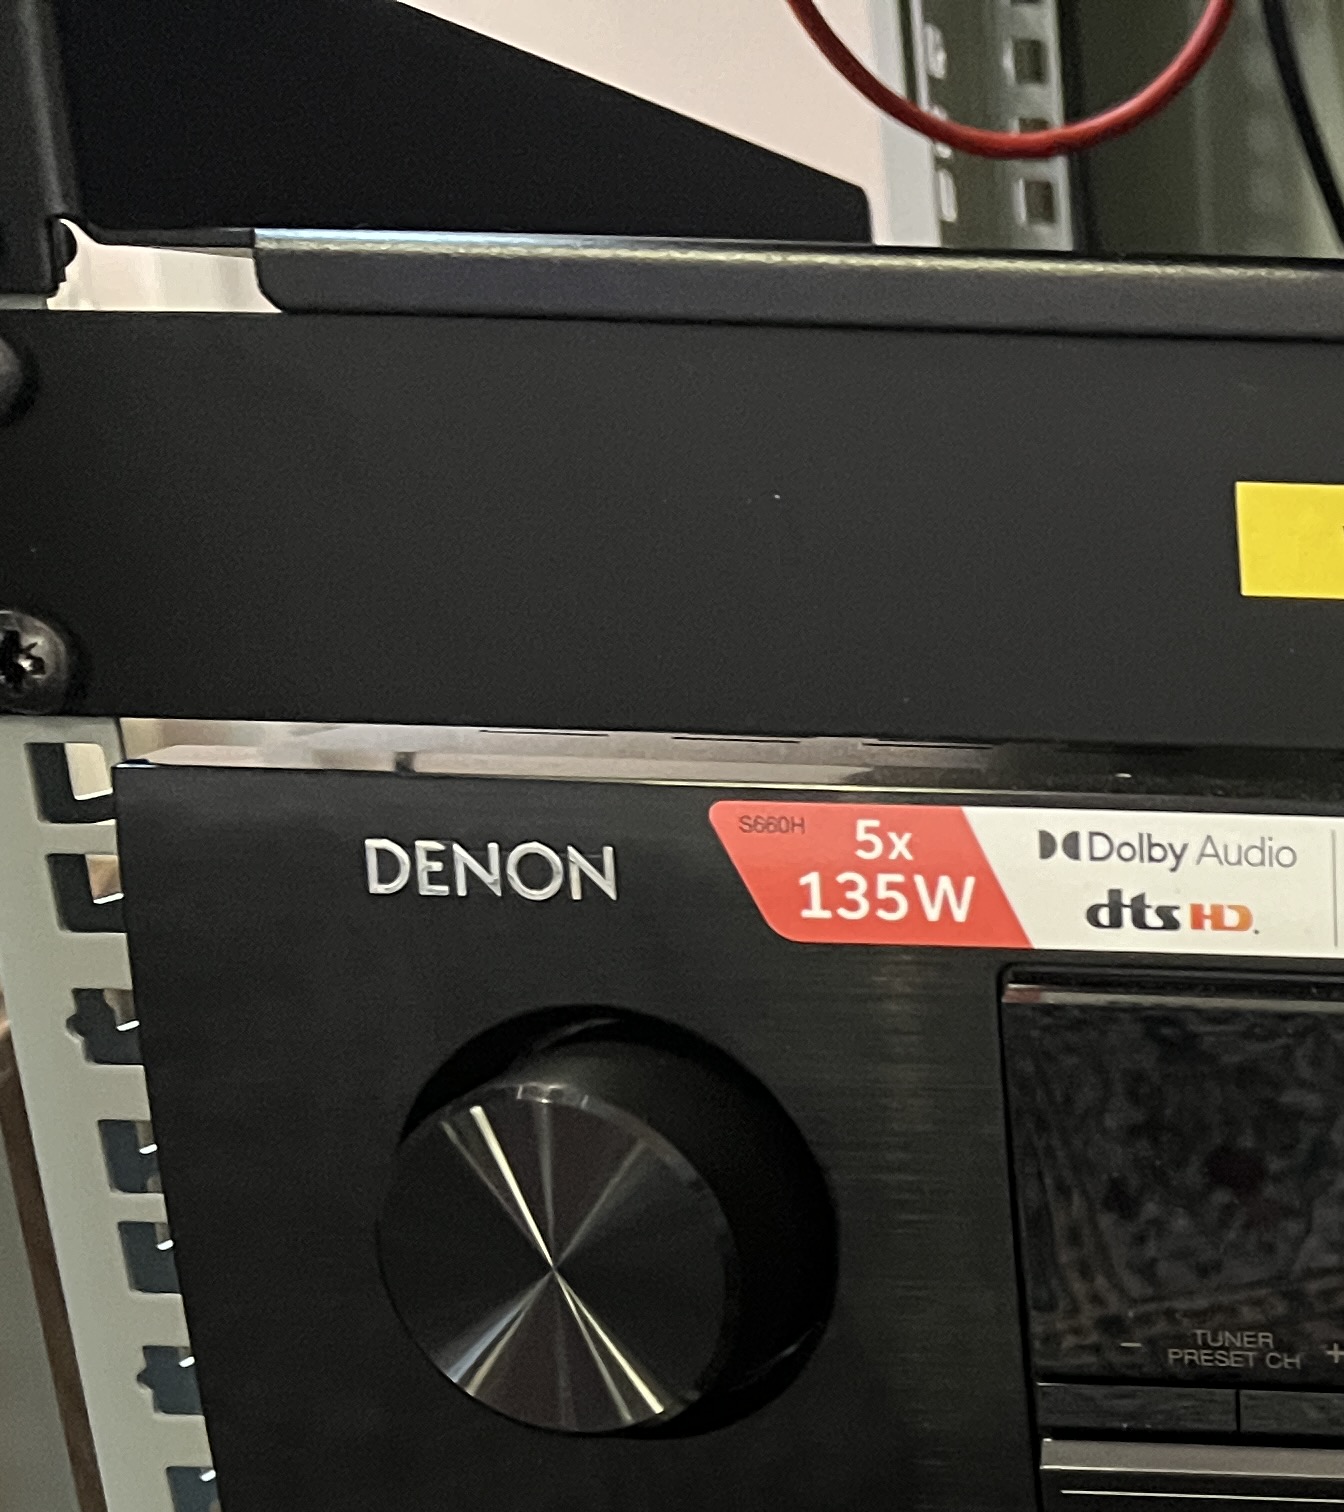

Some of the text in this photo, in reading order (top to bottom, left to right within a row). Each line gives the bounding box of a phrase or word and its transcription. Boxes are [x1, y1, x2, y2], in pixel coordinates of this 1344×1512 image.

[739, 815, 805, 834] S660H
[855, 819, 914, 860] 5x
[365, 837, 617, 901] DENON
[1088, 831, 1297, 873] Dolby Audio
[799, 871, 976, 923] 135W
[1086, 889, 1253, 931] dts HD
[1168, 1349, 1301, 1369] PRESET CH
[1194, 1329, 1274, 1348] TUNER
